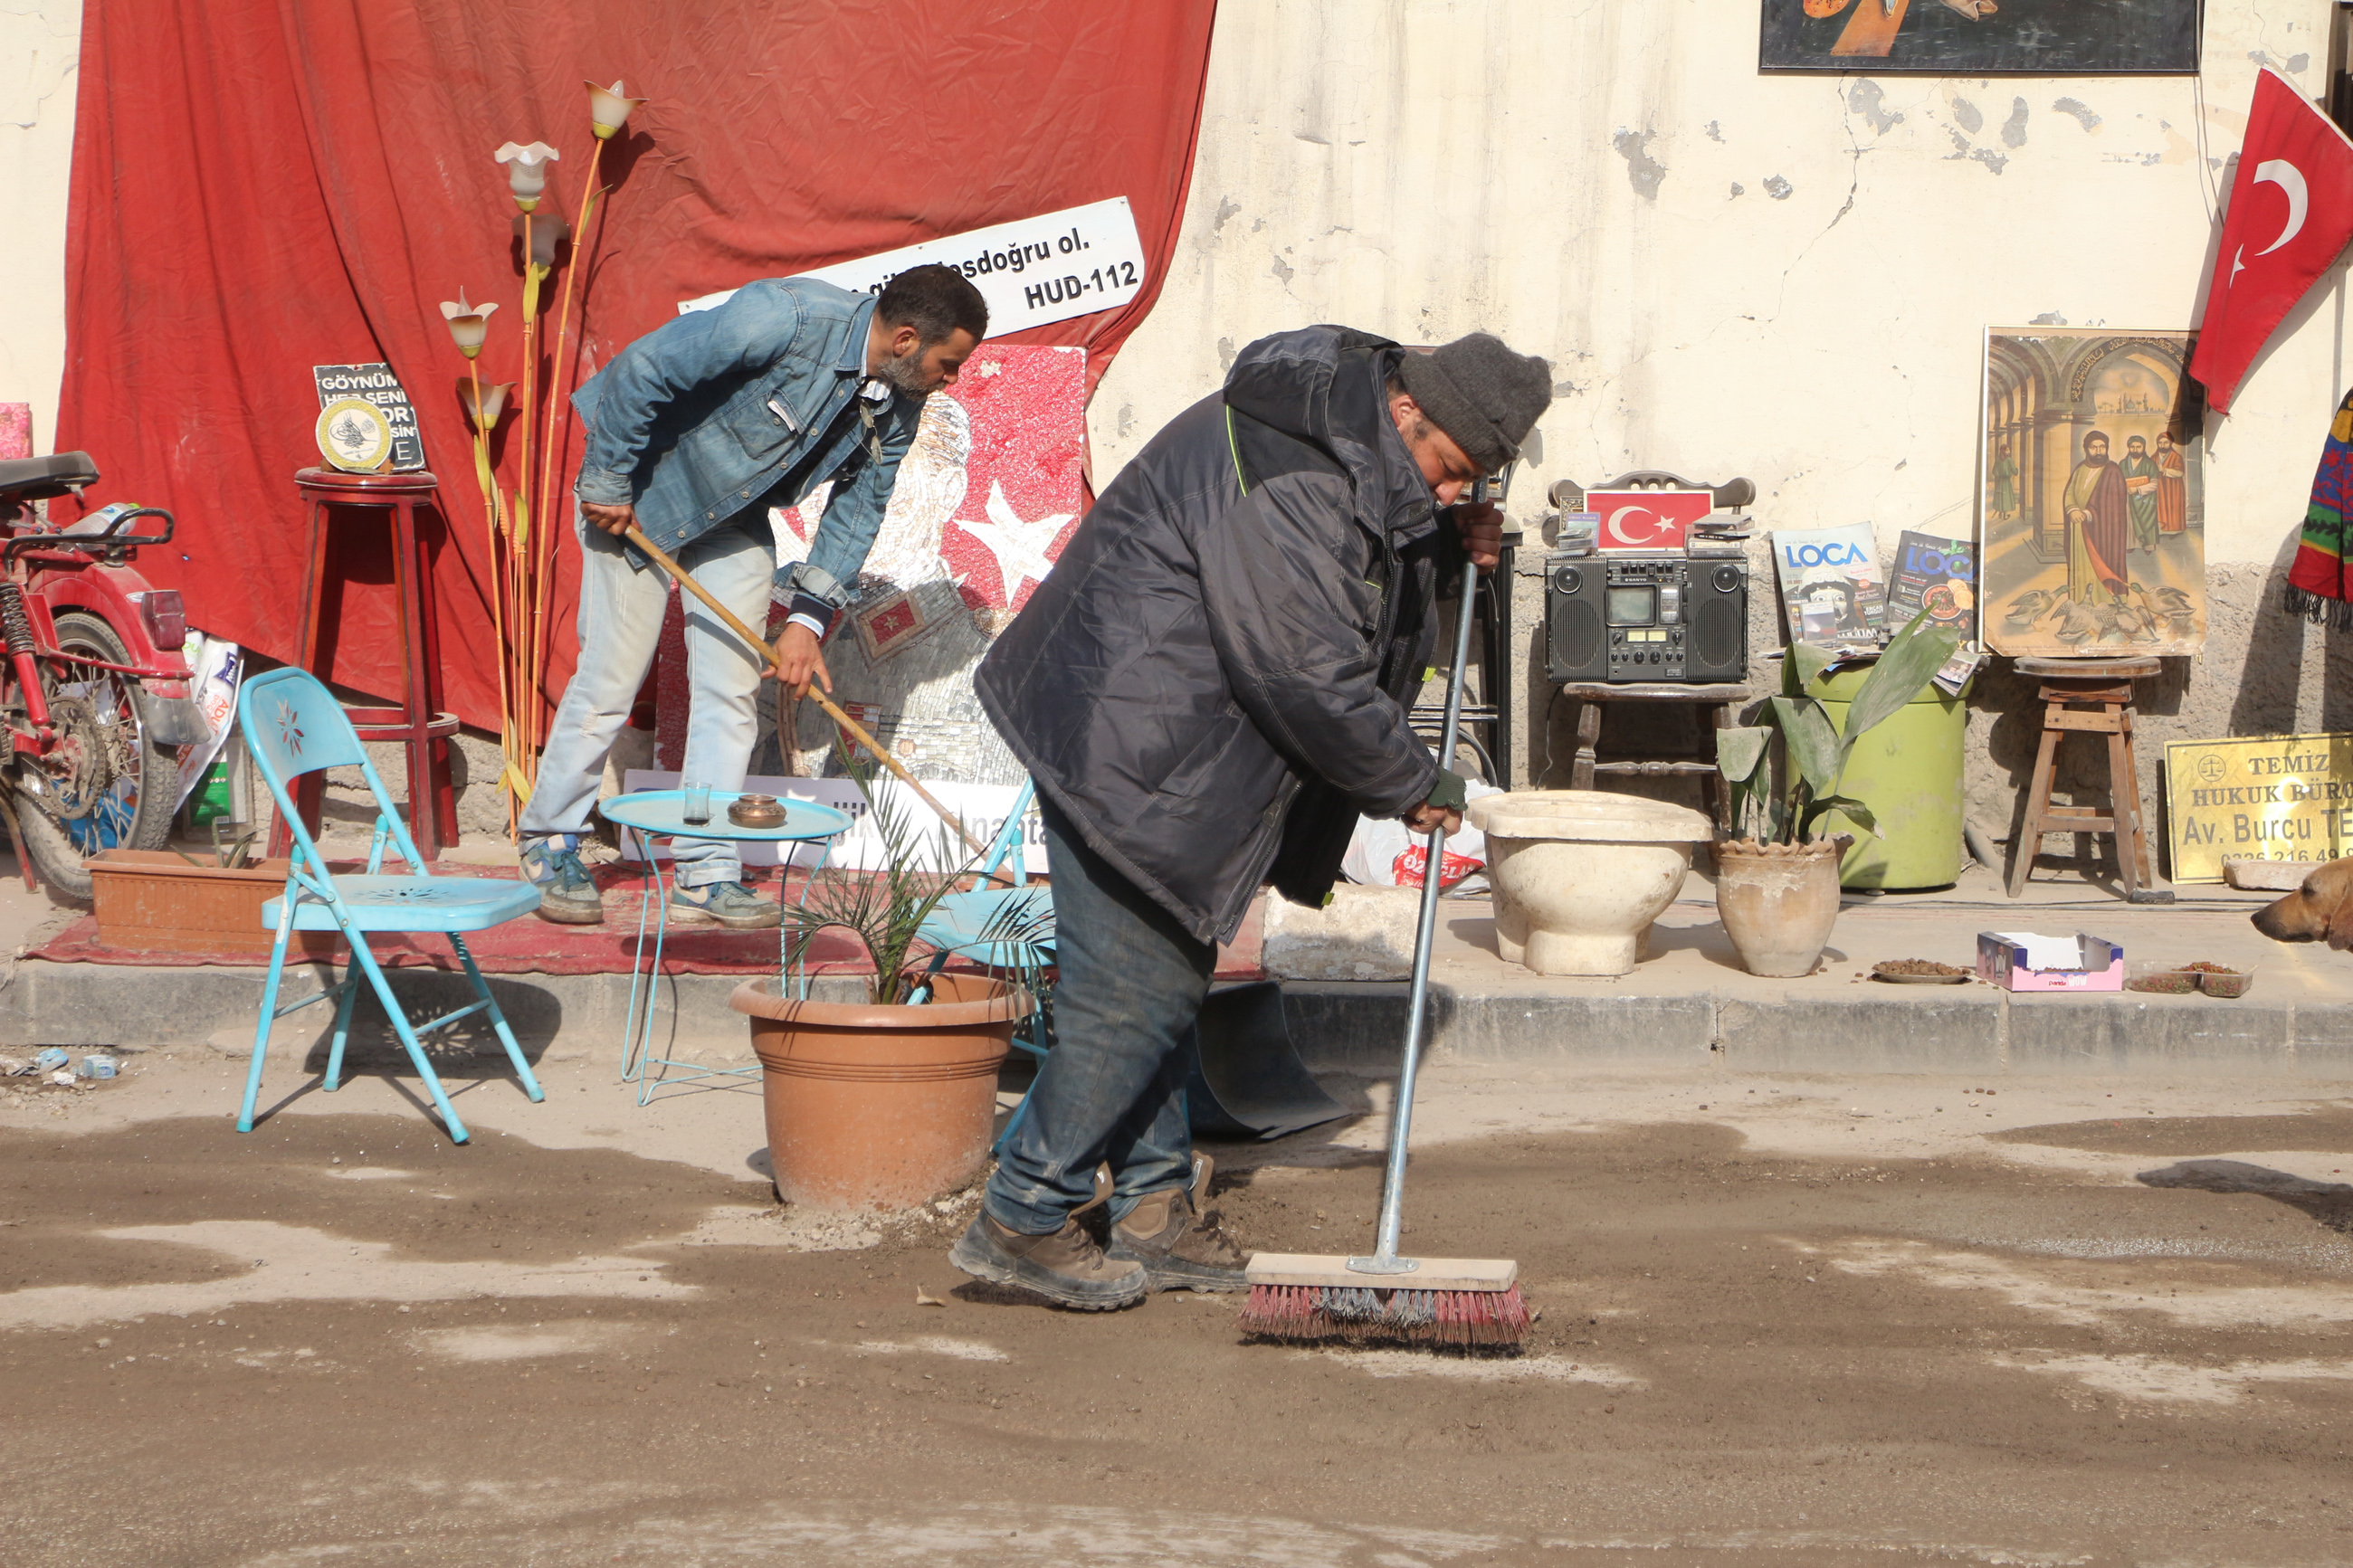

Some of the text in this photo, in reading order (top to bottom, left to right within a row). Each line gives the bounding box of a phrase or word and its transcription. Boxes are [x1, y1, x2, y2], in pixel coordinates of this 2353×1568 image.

[948, 242, 1051, 280] osdoğru
[1058, 227, 1090, 254] ol.
[1024, 261, 1138, 309] HUD-112
[1785, 542, 1868, 568] LOCA
[2248, 750, 2329, 775] TEMİZ
[2192, 785, 2282, 807] HUKUK
[2183, 815, 2224, 845] Av.
[2234, 813, 2311, 843] Burcu
[2068, 975, 2087, 987] WOW
